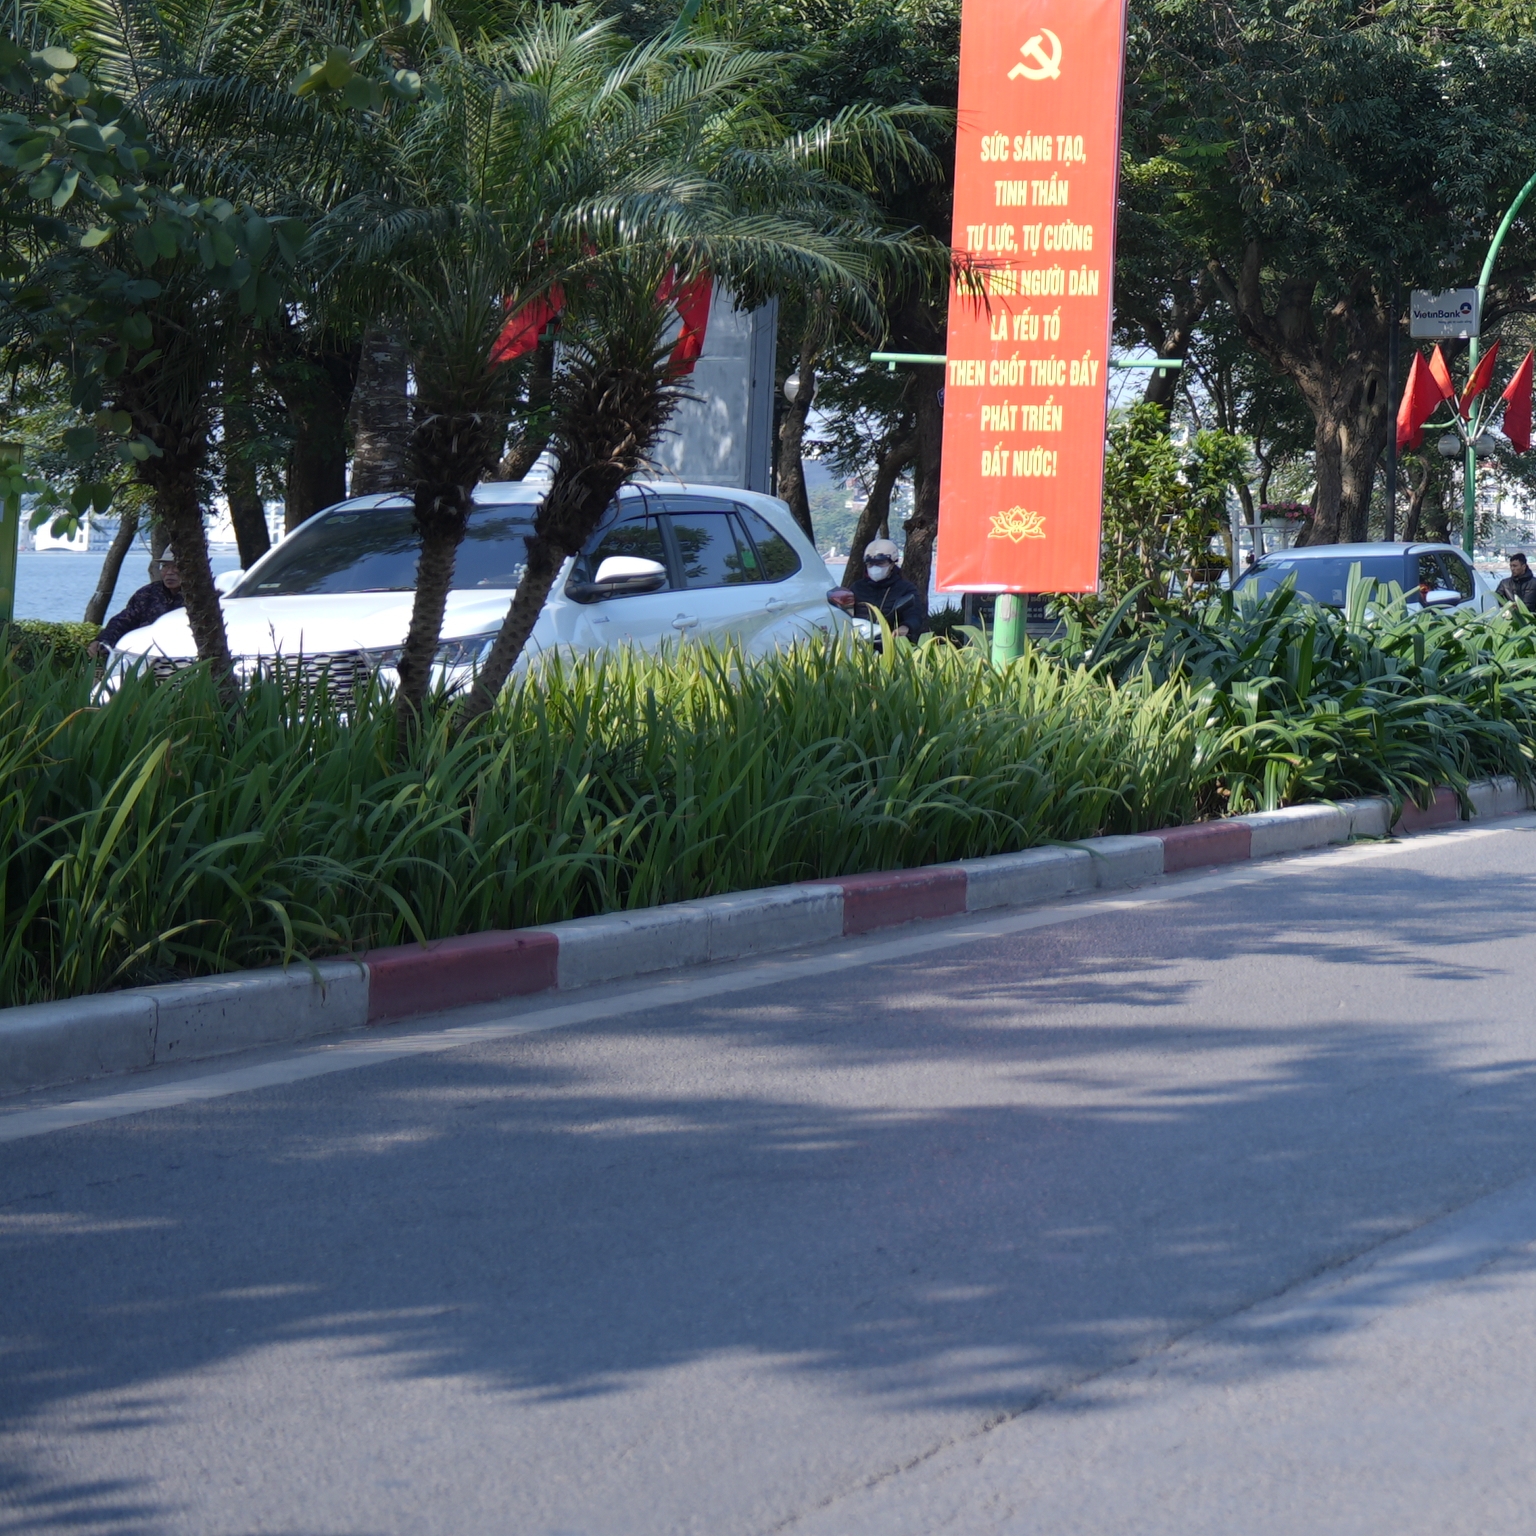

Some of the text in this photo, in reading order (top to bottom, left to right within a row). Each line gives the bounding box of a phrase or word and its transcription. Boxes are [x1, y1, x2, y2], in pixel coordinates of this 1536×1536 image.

[980, 130, 1086, 167] SỨC SÁNG TẠO,
[995, 171, 1069, 206] TINH THẦN
[966, 219, 1093, 257] TỰ LỰC, TỰ CƯỜNG
[1020, 263, 1065, 296] NGƯỜI
[1068, 264, 1099, 296] DÂN
[990, 306, 1061, 341] LÀ YẾU TỐ
[1414, 310, 1460, 318] VietinBank
[949, 349, 1099, 386] THEN CHỐT THÚC ĐẨY
[980, 394, 1063, 431] PHÁT TRIỂN
[981, 441, 1057, 477] ĐẤT NƯỚC!
